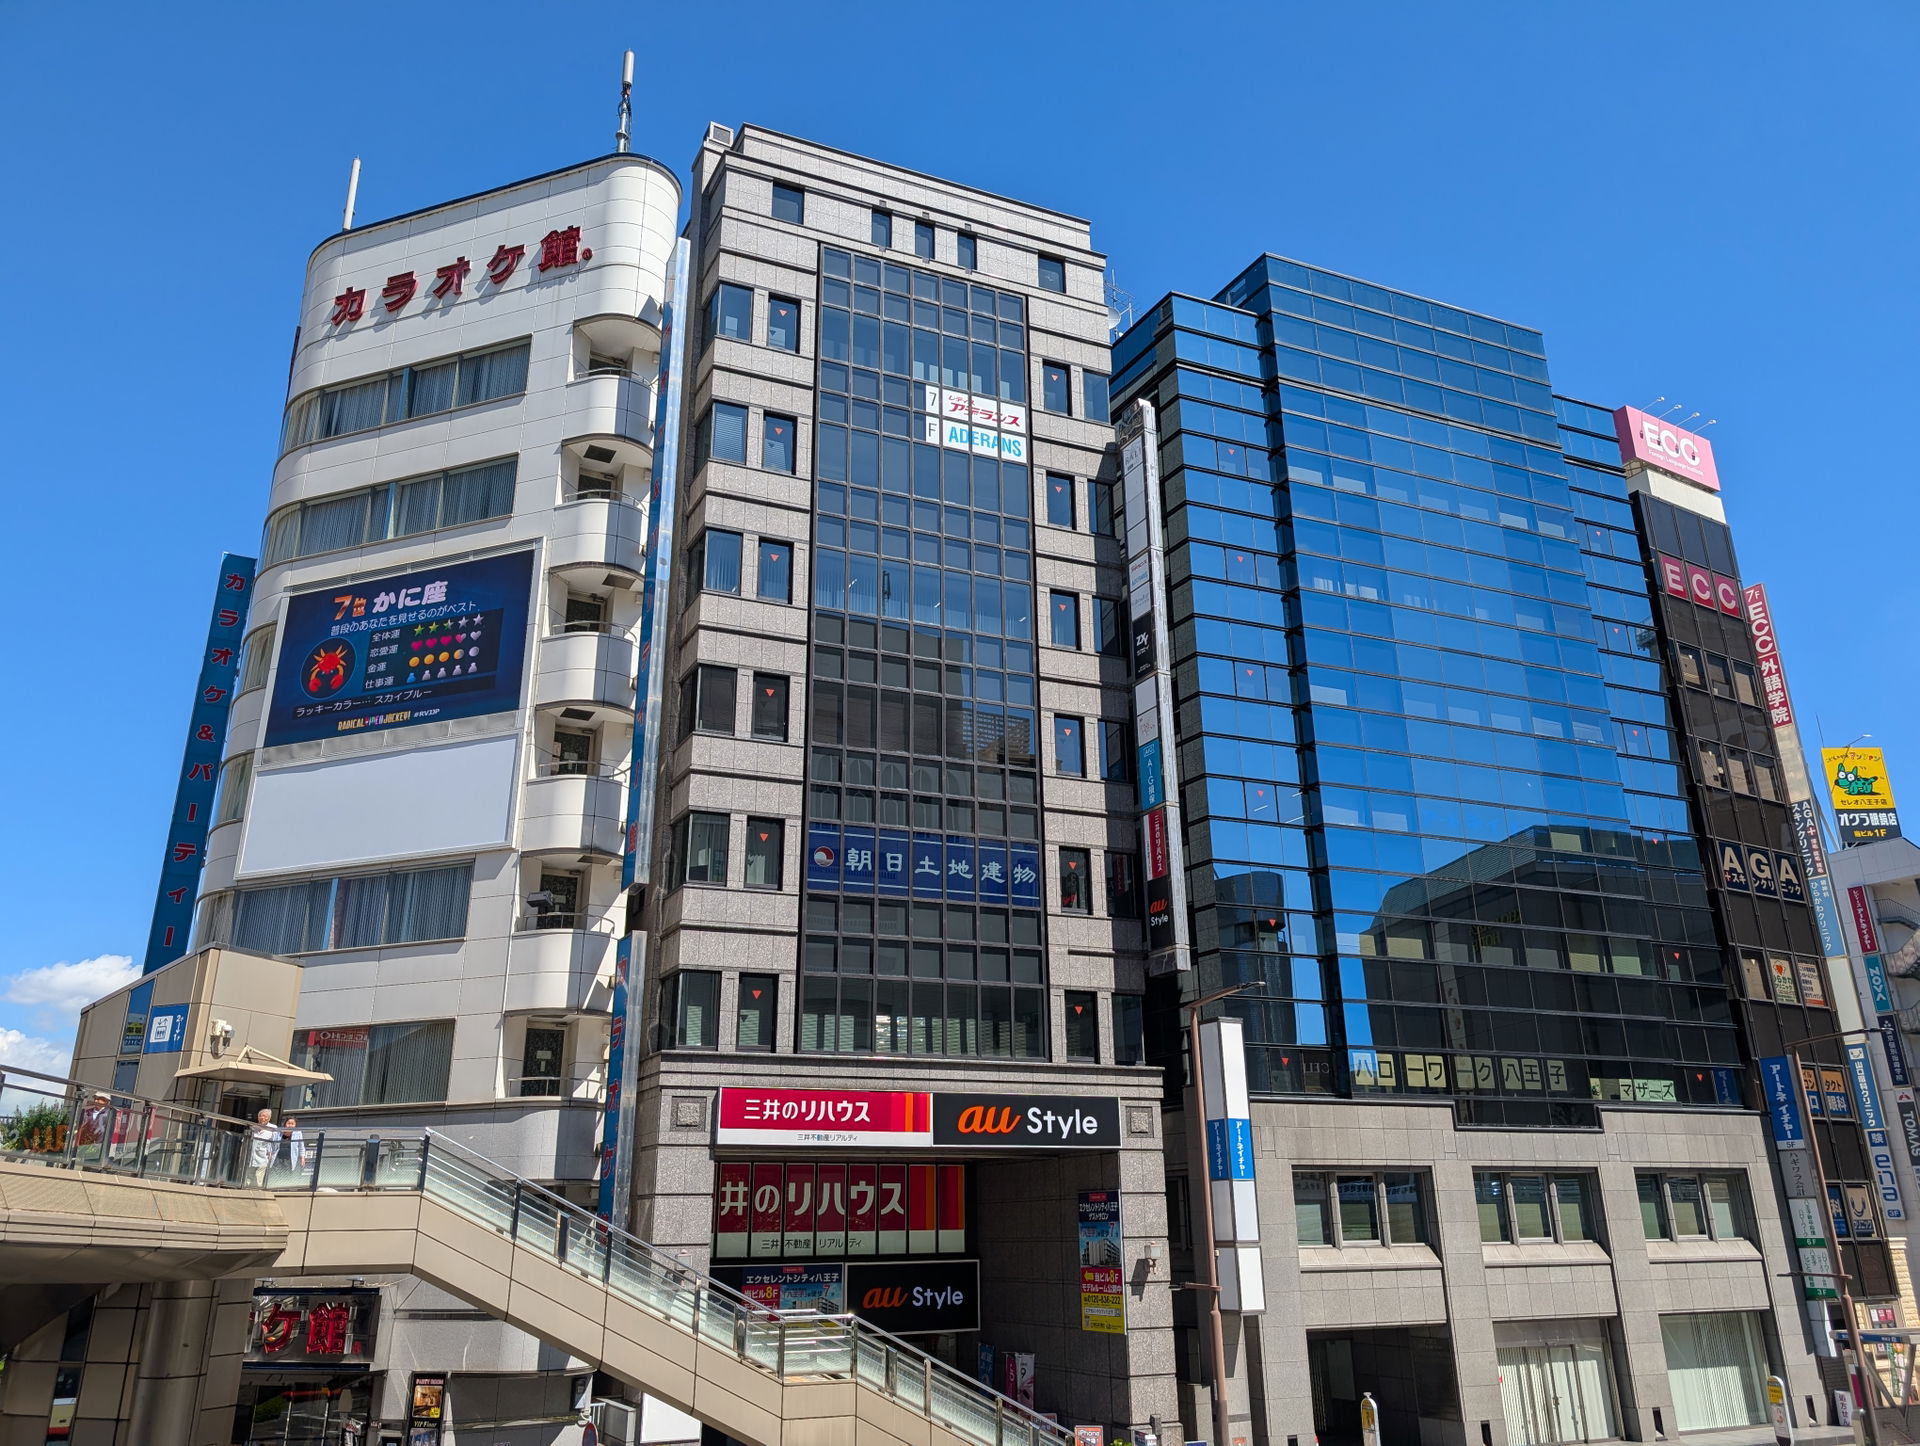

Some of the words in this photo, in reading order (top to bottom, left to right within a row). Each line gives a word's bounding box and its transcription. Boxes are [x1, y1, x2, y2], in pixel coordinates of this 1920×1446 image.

[331, 224, 582, 325] カラオケ館
[948, 426, 1022, 457] ADERANS
[1642, 420, 1700, 466] ECC
[372, 580, 448, 614] かに座
[1664, 562, 1737, 610] ECC
[1745, 588, 1760, 602] 7F
[372, 629, 401, 643] 全体運
[369, 645, 399, 658] 恋愛運
[367, 662, 387, 674] 金運
[365, 676, 394, 689] 仕事運
[1760, 657, 1790, 723] 外語学院
[375, 689, 433, 705] スカイブルー
[1802, 801, 1815, 827] AGA
[1838, 812, 1898, 827] オグラ眼鏡店
[1792, 804, 1814, 876] スキンクリニック
[845, 847, 1036, 884] 朝日土地建物
[1723, 846, 1799, 884] AGA
[1731, 872, 1802, 895] スキンクリニック
[1149, 899, 1168, 914] au
[1810, 881, 1832, 951] ひらかわクリニック
[1150, 913, 1169, 927] Style
[1869, 966, 1887, 1002] NOVA
[1355, 1054, 1567, 1087] ハローワーク八王子
[1620, 1082, 1675, 1099] マザーズ
[743, 1098, 871, 1123] 三井のリハウス
[957, 1105, 1022, 1134] au
[1026, 1107, 1098, 1139] Style
[796, 1132, 858, 1142] 三井不動産リアルティ
[1786, 1141, 1796, 1149] 5F
[1902, 1111, 1920, 1157] TOMAS
[760, 1237, 862, 1249] 三井不動産リアルティ
[746, 1272, 839, 1284] エクセレントシティ八王子
[862, 1286, 909, 1309] au
[912, 1285, 964, 1311] Style
[250, 1302, 351, 1355] ケ館
